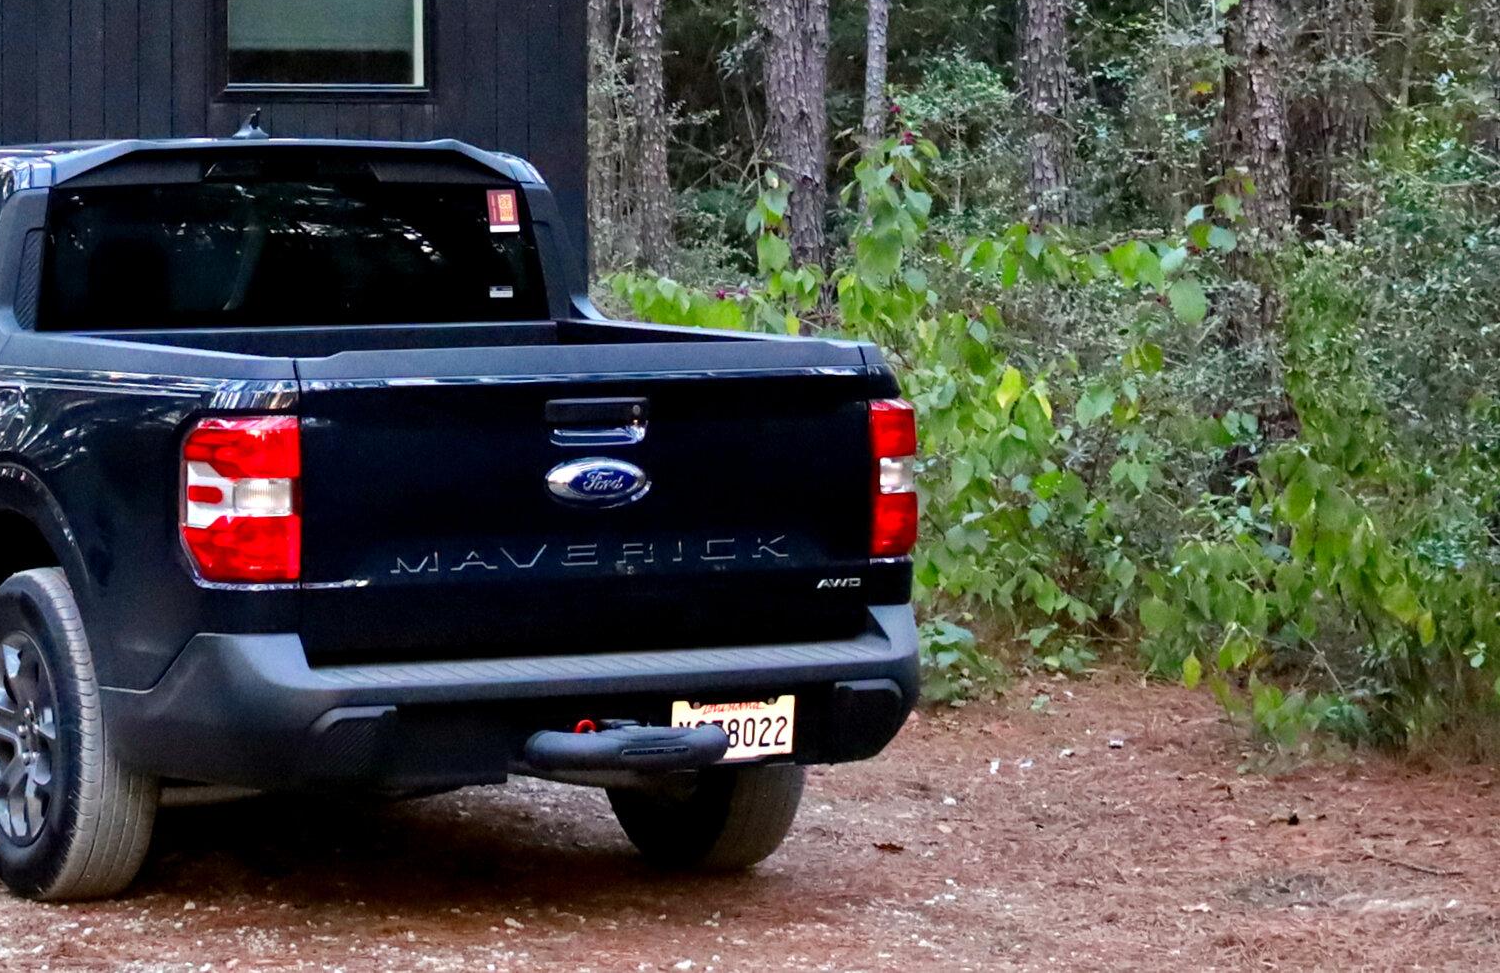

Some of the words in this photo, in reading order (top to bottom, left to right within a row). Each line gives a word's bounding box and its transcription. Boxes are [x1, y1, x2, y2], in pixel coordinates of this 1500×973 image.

[583, 468, 624, 491] Ford
[390, 534, 790, 573] MAVERICK
[816, 577, 862, 590] AWD
[678, 715, 788, 748] 8022
